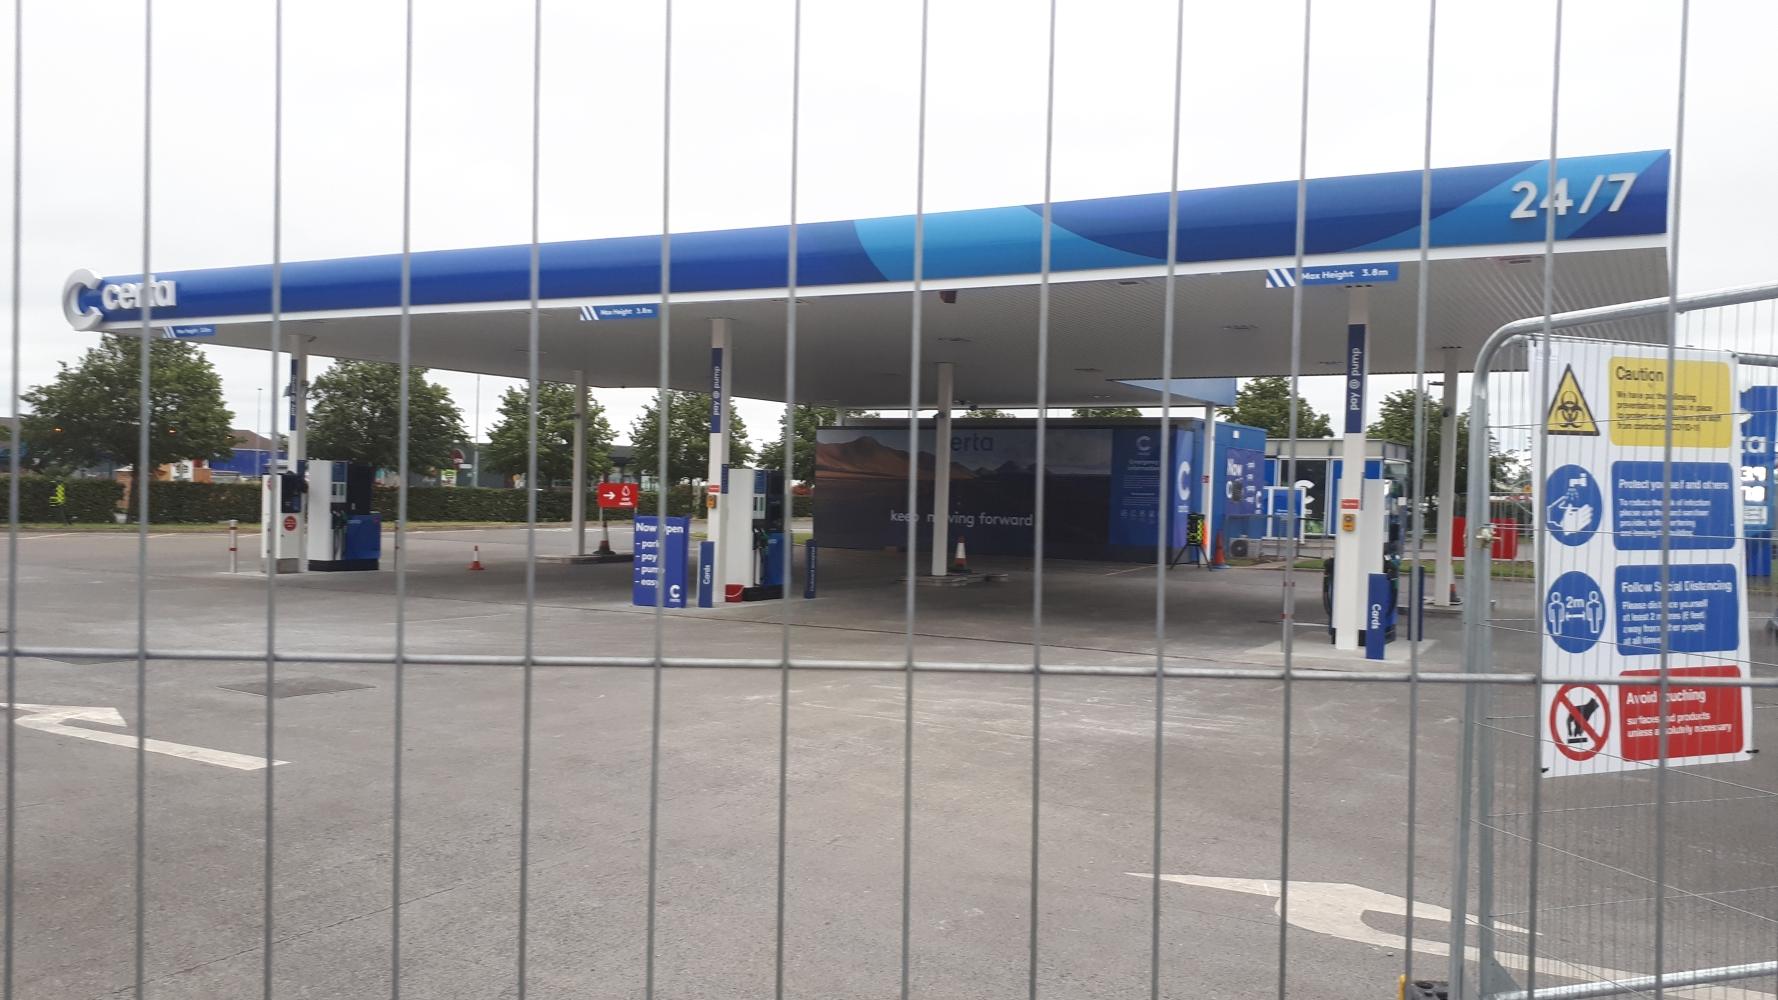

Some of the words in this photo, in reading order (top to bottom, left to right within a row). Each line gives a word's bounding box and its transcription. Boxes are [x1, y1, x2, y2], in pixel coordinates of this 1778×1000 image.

[1510, 172, 1638, 219] 24/7
[1301, 272, 1320, 280] Max
[1322, 270, 1354, 280] Height
[1361, 268, 1388, 277] 3.8m
[1352, 348, 1362, 376] pump
[1616, 366, 1664, 382] Caution
[1350, 392, 1360, 410] pay
[951, 432, 994, 450] erta
[1618, 479, 1650, 489] Protect
[1650, 480, 1684, 491] youself
[1686, 480, 1702, 489] and
[890, 510, 920, 524] keep
[926, 512, 974, 528] mving
[979, 512, 1033, 526] forward
[636, 522, 658, 532] Now
[641, 554, 658, 562] pay
[640, 579, 658, 588] easy
[1622, 582, 1652, 593] Follow
[1654, 582, 1683, 592] Scial
[1566, 596, 1585, 608] 2m
[1648, 600, 1678, 609] distce
[1372, 604, 1382, 630] Cards
[1626, 691, 1658, 705] Avoid
[1666, 689, 1706, 704] ouching
[1654, 725, 1693, 736] aolutely
